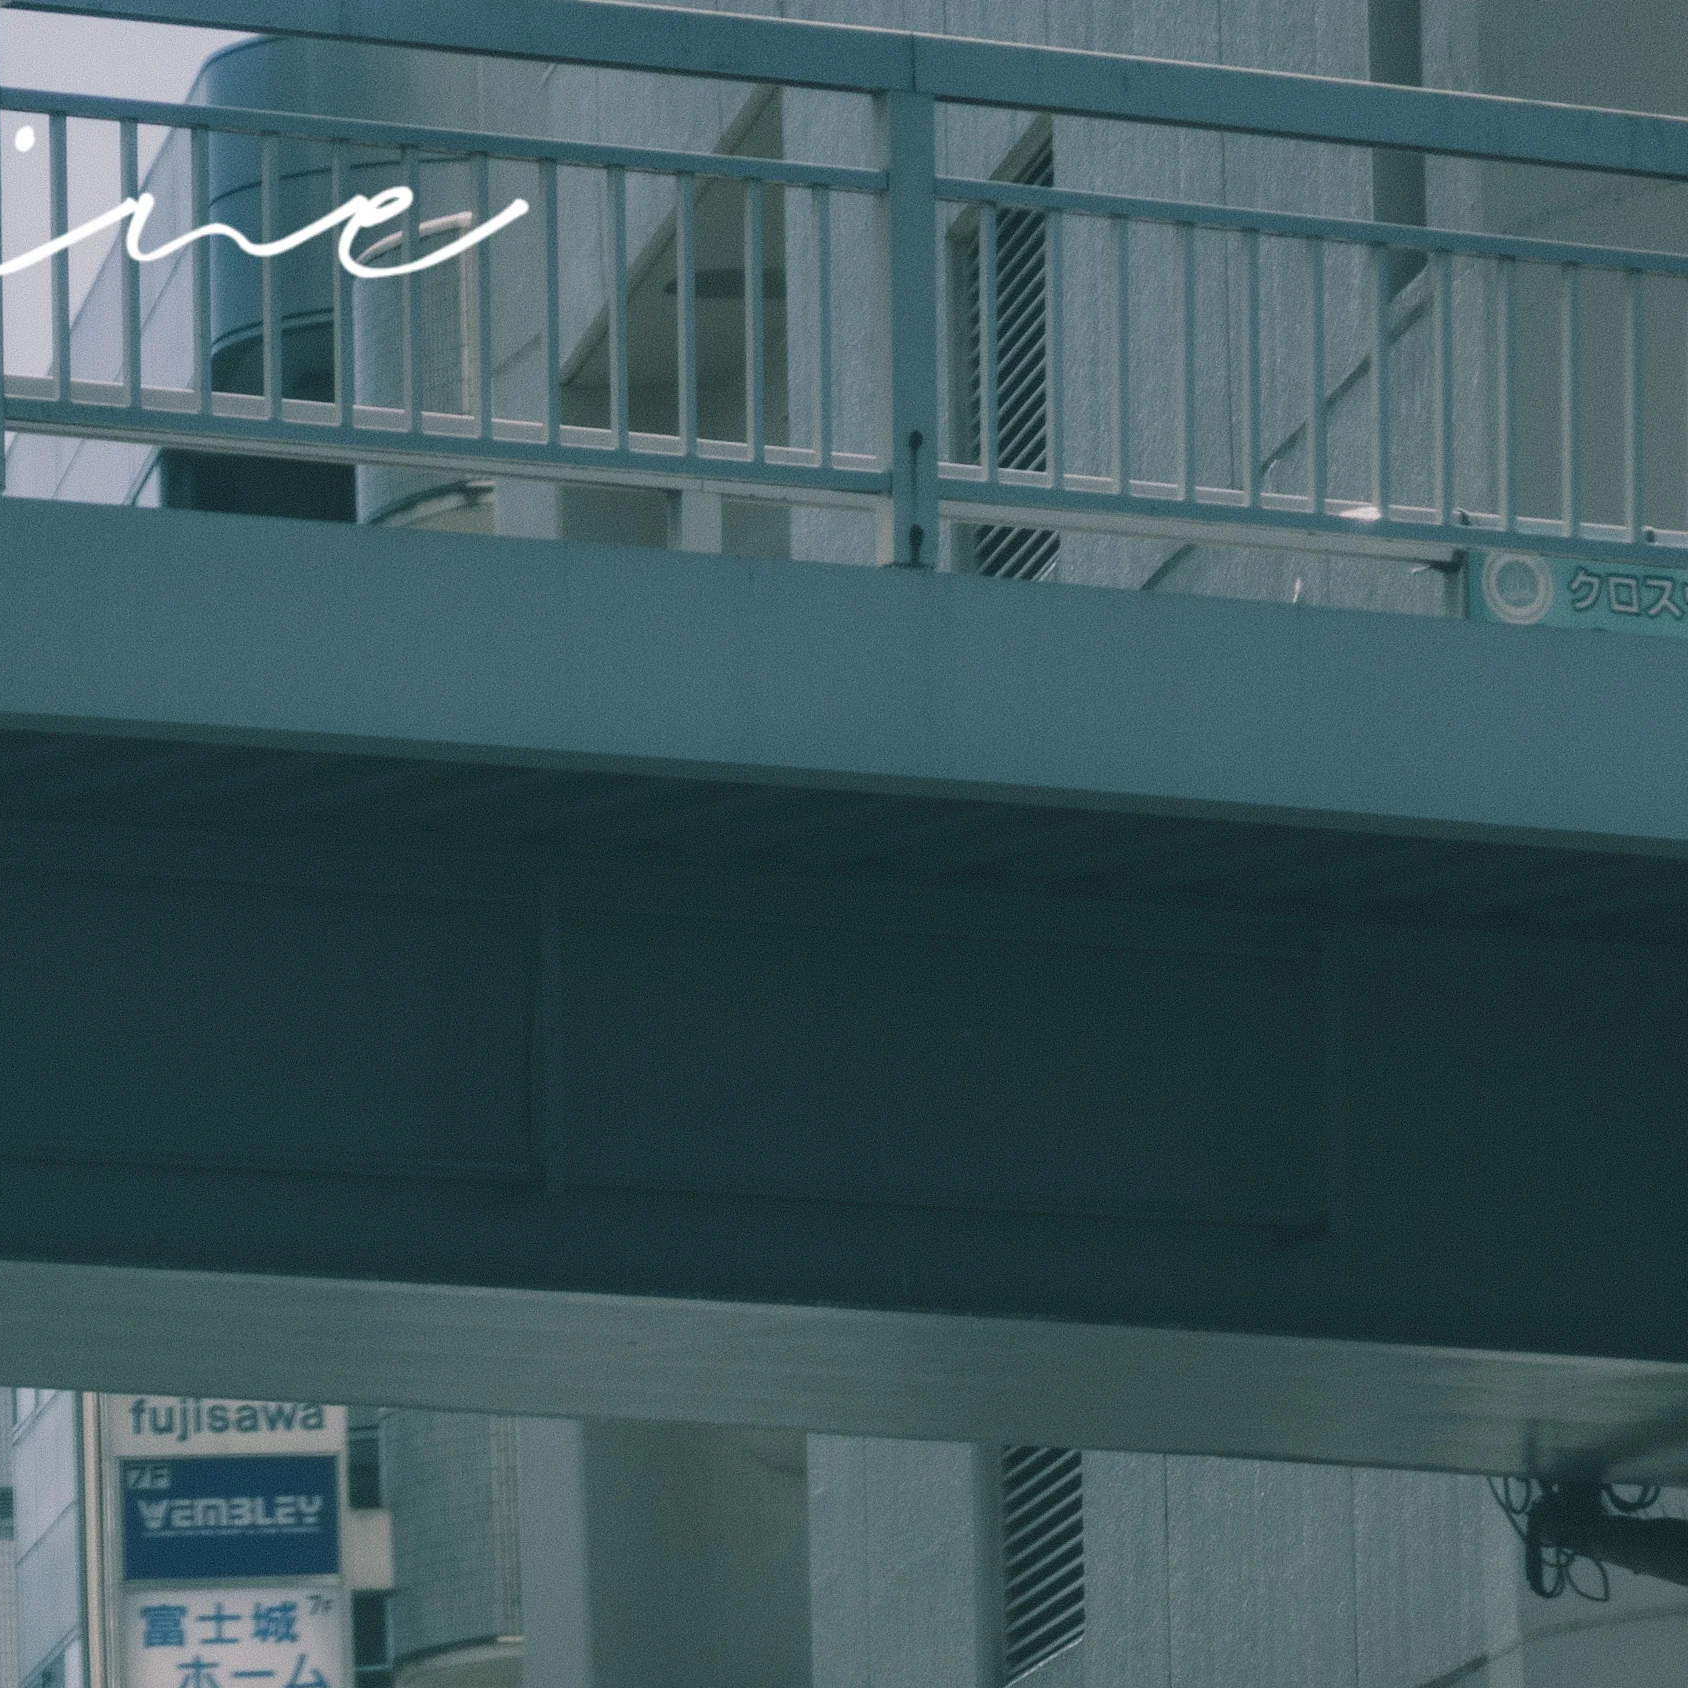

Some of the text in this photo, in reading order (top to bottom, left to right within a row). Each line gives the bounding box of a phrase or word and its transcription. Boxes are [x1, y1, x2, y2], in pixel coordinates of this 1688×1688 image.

[1569, 564, 1688, 620] クロス
[139, 1601, 301, 1649] 富士城
